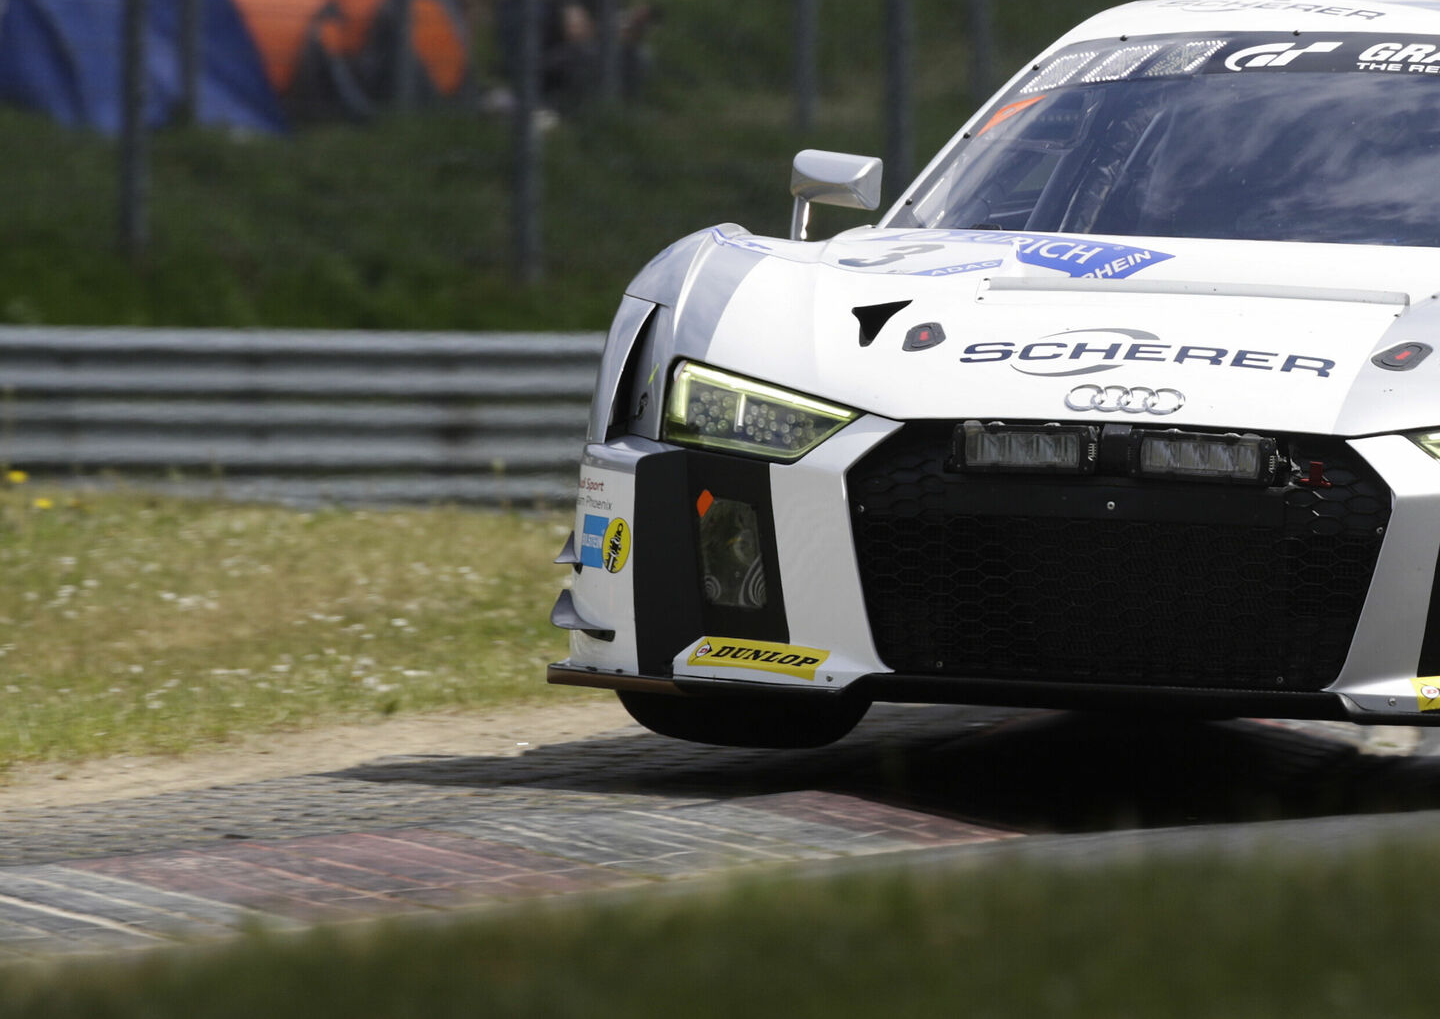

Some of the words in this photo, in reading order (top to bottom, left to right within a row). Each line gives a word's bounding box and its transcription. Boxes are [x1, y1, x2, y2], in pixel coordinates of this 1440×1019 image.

[1167, 0, 1386, 20] SCHERER
[1356, 62, 1402, 72] THE
[931, 260, 999, 276] ADAC
[959, 342, 1336, 378] SCHERER
[710, 646, 820, 667] DUNLOP
